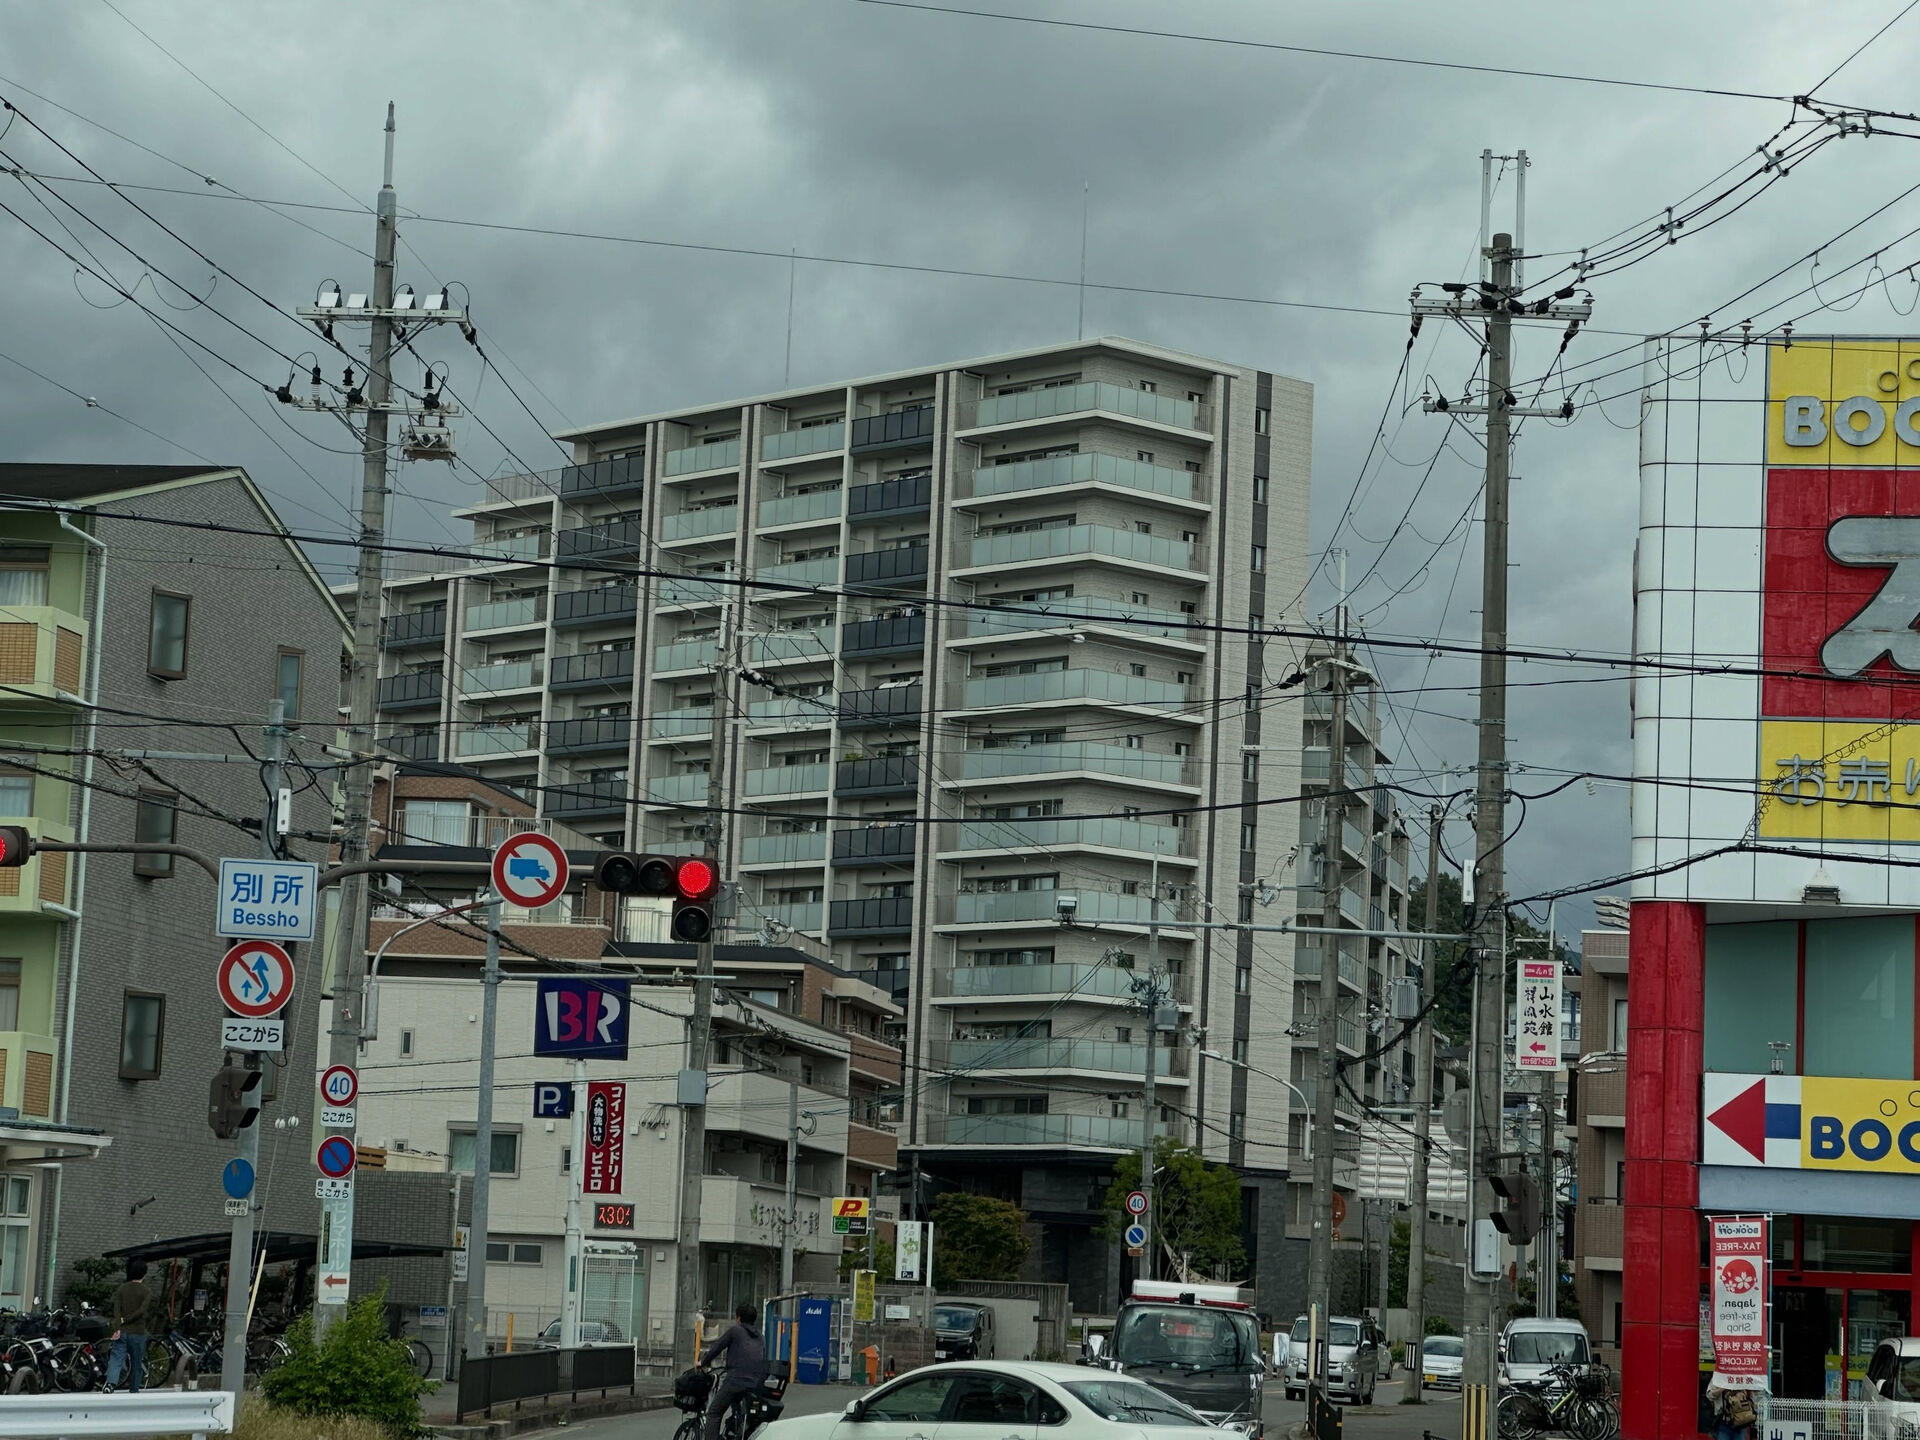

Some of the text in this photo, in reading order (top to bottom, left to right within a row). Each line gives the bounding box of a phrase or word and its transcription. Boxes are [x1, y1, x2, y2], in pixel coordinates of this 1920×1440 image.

[230, 872, 304, 906] 別所
[232, 908, 299, 927] Bessho
[544, 990, 621, 1043] BR
[1539, 986, 1555, 1036] 山水館
[224, 1025, 280, 1043] ここから
[329, 1077, 350, 1095] 40
[538, 1086, 562, 1114] P
[321, 1111, 353, 1123] ここから
[607, 1086, 623, 1191] コインランドリー
[590, 1152, 604, 1191] ピエロ
[316, 1188, 349, 1199] ここから
[1131, 1198, 1143, 1208] 40
[838, 1200, 862, 1216] P
[329, 1200, 347, 1272] セレマホール
